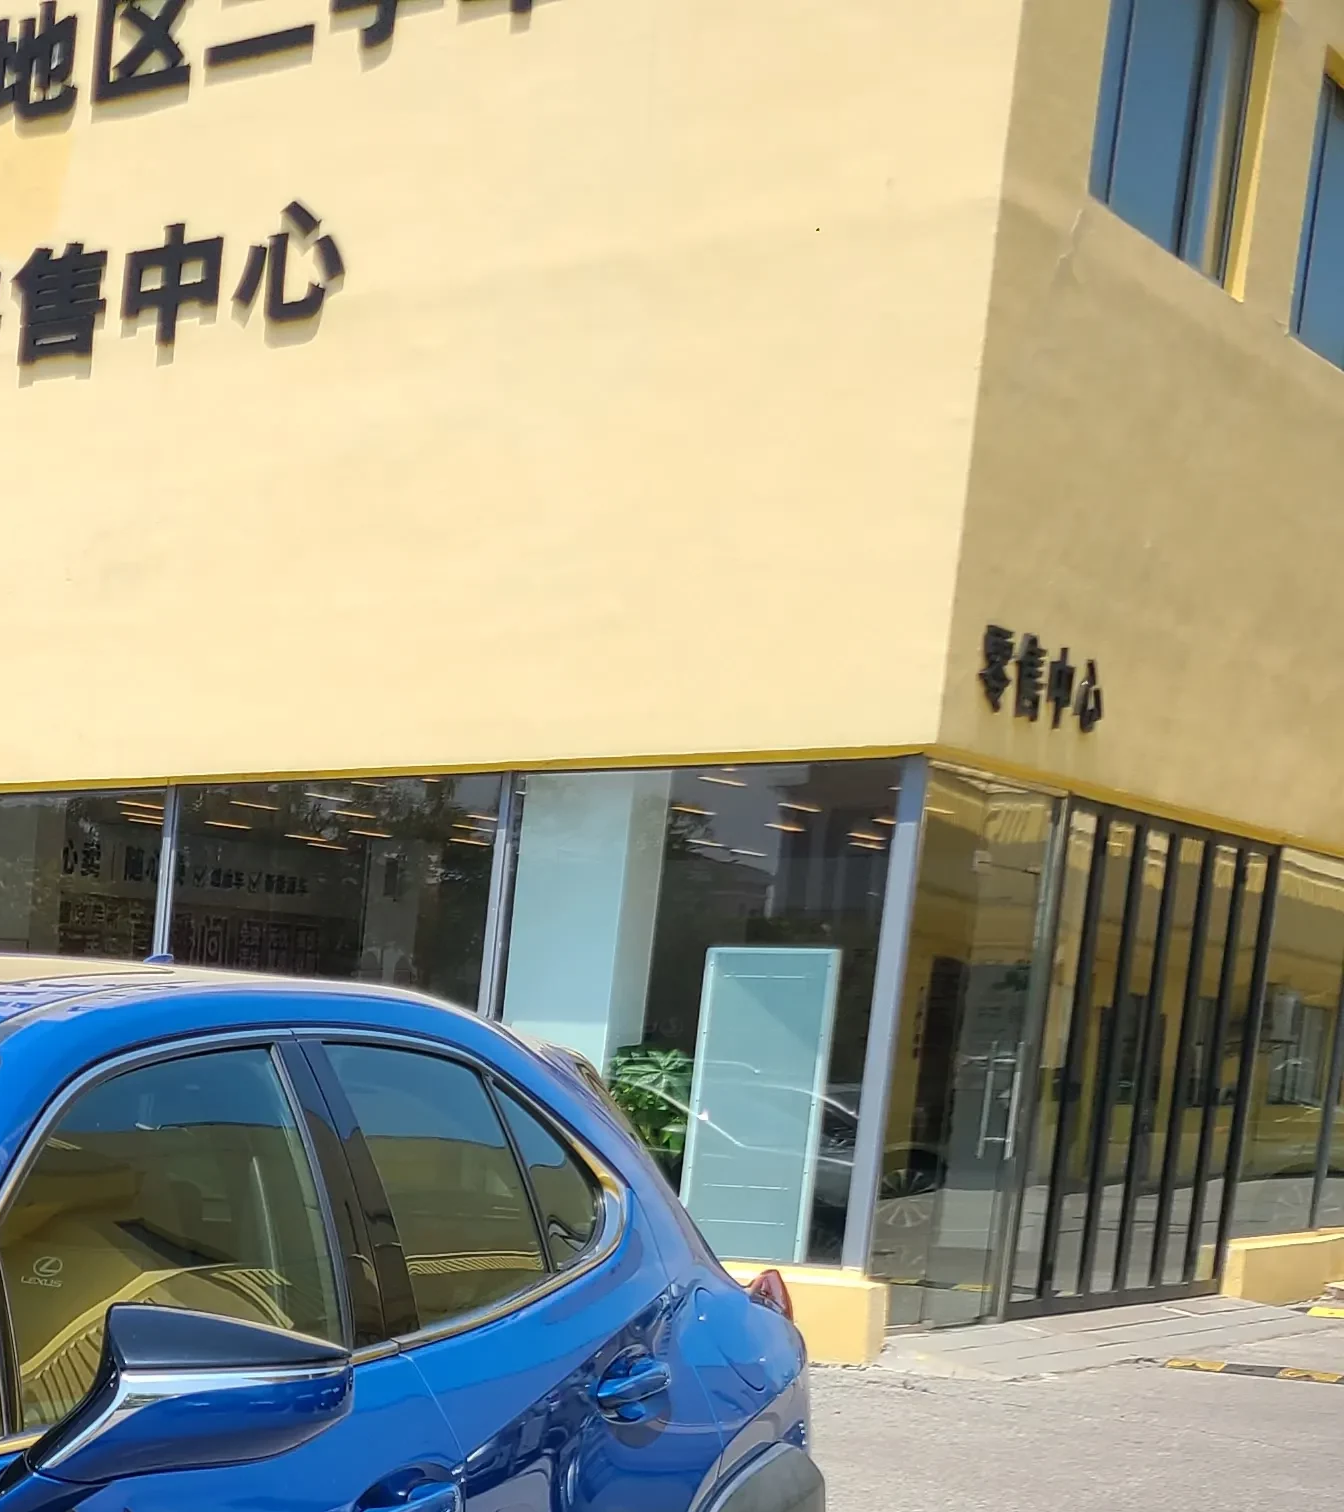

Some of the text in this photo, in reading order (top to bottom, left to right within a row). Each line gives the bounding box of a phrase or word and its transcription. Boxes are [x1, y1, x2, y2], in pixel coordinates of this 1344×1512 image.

[978, 624, 1103, 734] 零售中心
[21, 1276, 63, 1288] LEXUS
